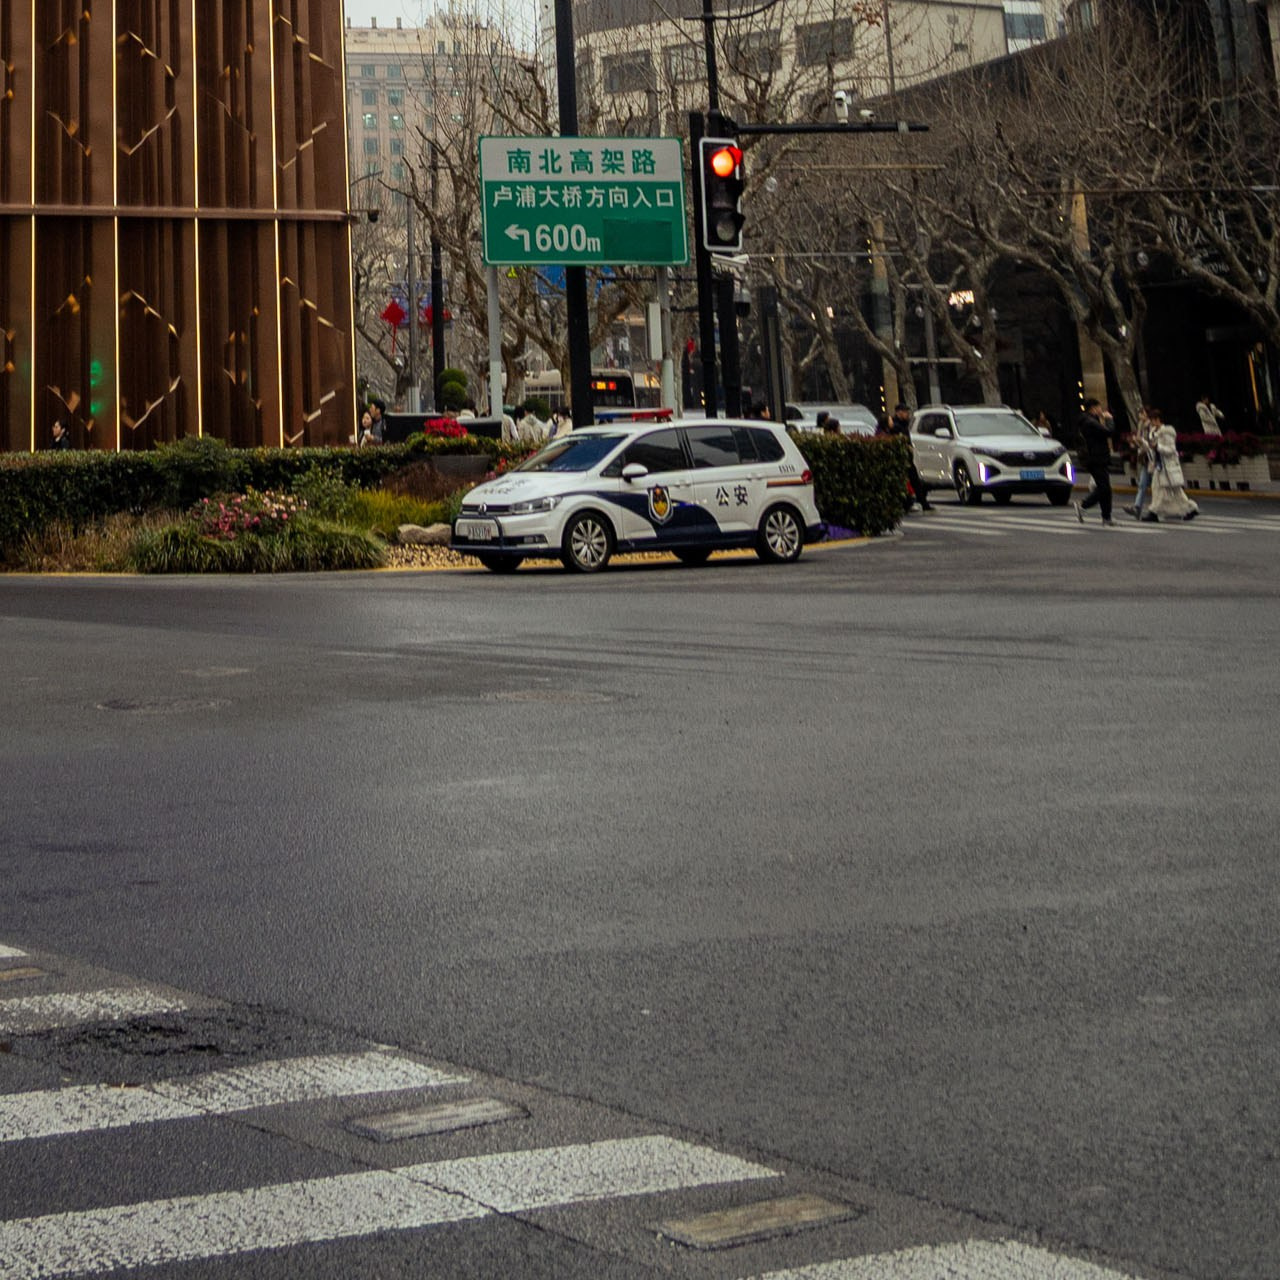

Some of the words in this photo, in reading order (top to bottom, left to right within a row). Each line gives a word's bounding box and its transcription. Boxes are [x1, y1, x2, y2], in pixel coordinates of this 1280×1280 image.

[506, 148, 656, 175] 南北高架路
[492, 185, 674, 209] 卢浦大桥方向入口
[535, 223, 601, 253] 600m
[716, 484, 748, 507] 公安
